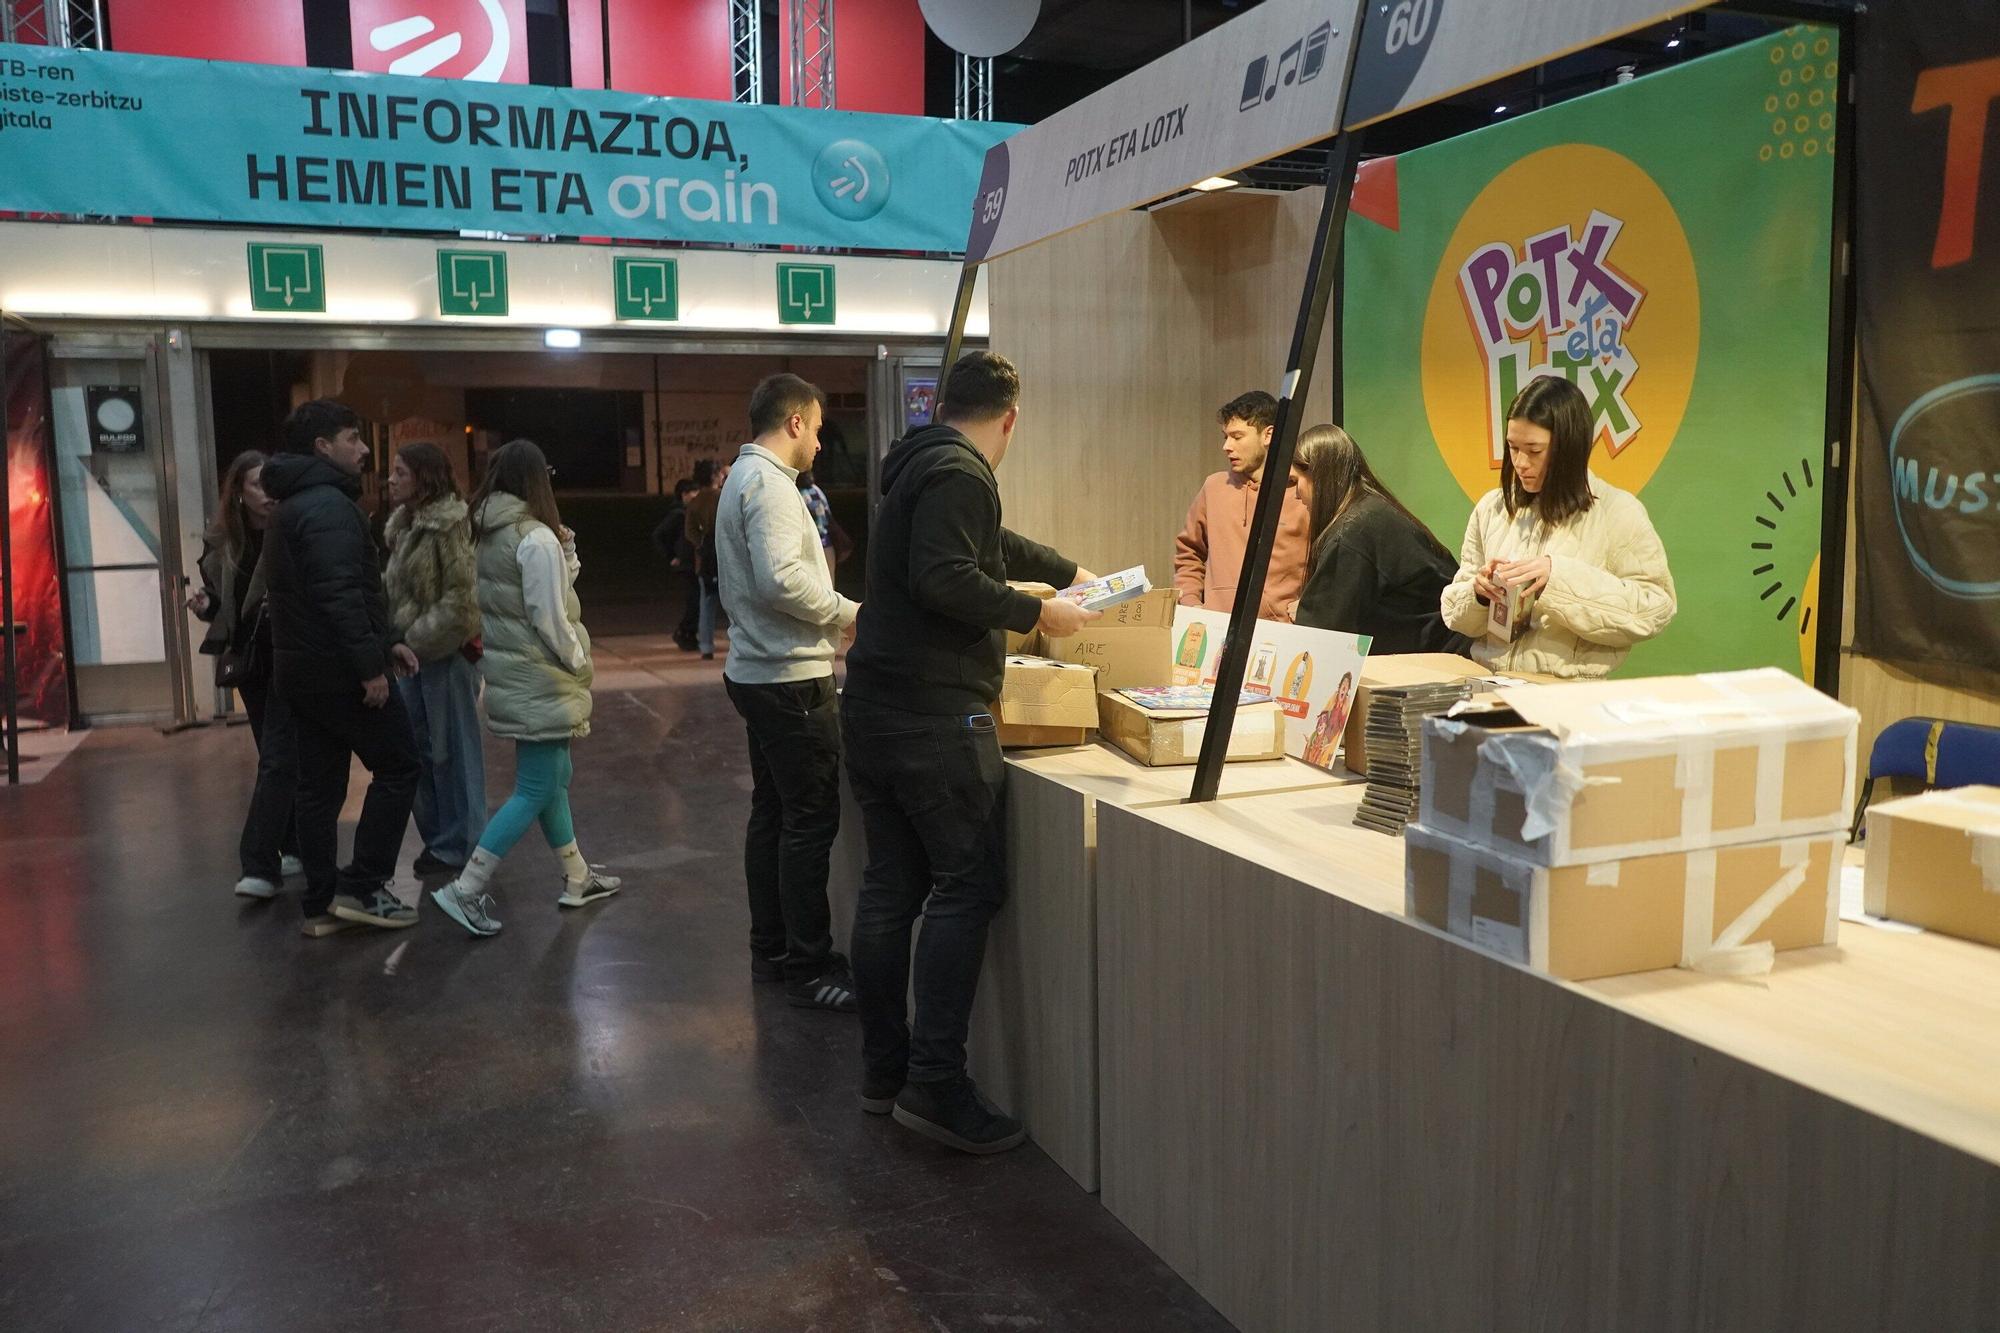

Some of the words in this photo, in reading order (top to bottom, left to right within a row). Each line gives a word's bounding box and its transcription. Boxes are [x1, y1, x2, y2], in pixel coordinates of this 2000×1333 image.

[1385, 0, 1433, 54] 60
[0, 82, 142, 111] iste-zerbitzu
[0, 107, 52, 131] itala
[300, 88, 748, 173] INFORMAZIOA,
[1065, 143, 1105, 187] POTX
[1106, 128, 1137, 168] ETA
[1141, 103, 1189, 152] LOTX
[246, 153, 472, 209] HEMEN
[491, 168, 594, 217] ETA
[607, 169, 778, 225] orain
[982, 186, 1004, 226] 59
[1567, 291, 1622, 360] eta
[1498, 349, 1631, 438] LTX
[1118, 602, 1129, 624] AIRE
[1074, 642, 1107, 656] AIRE
